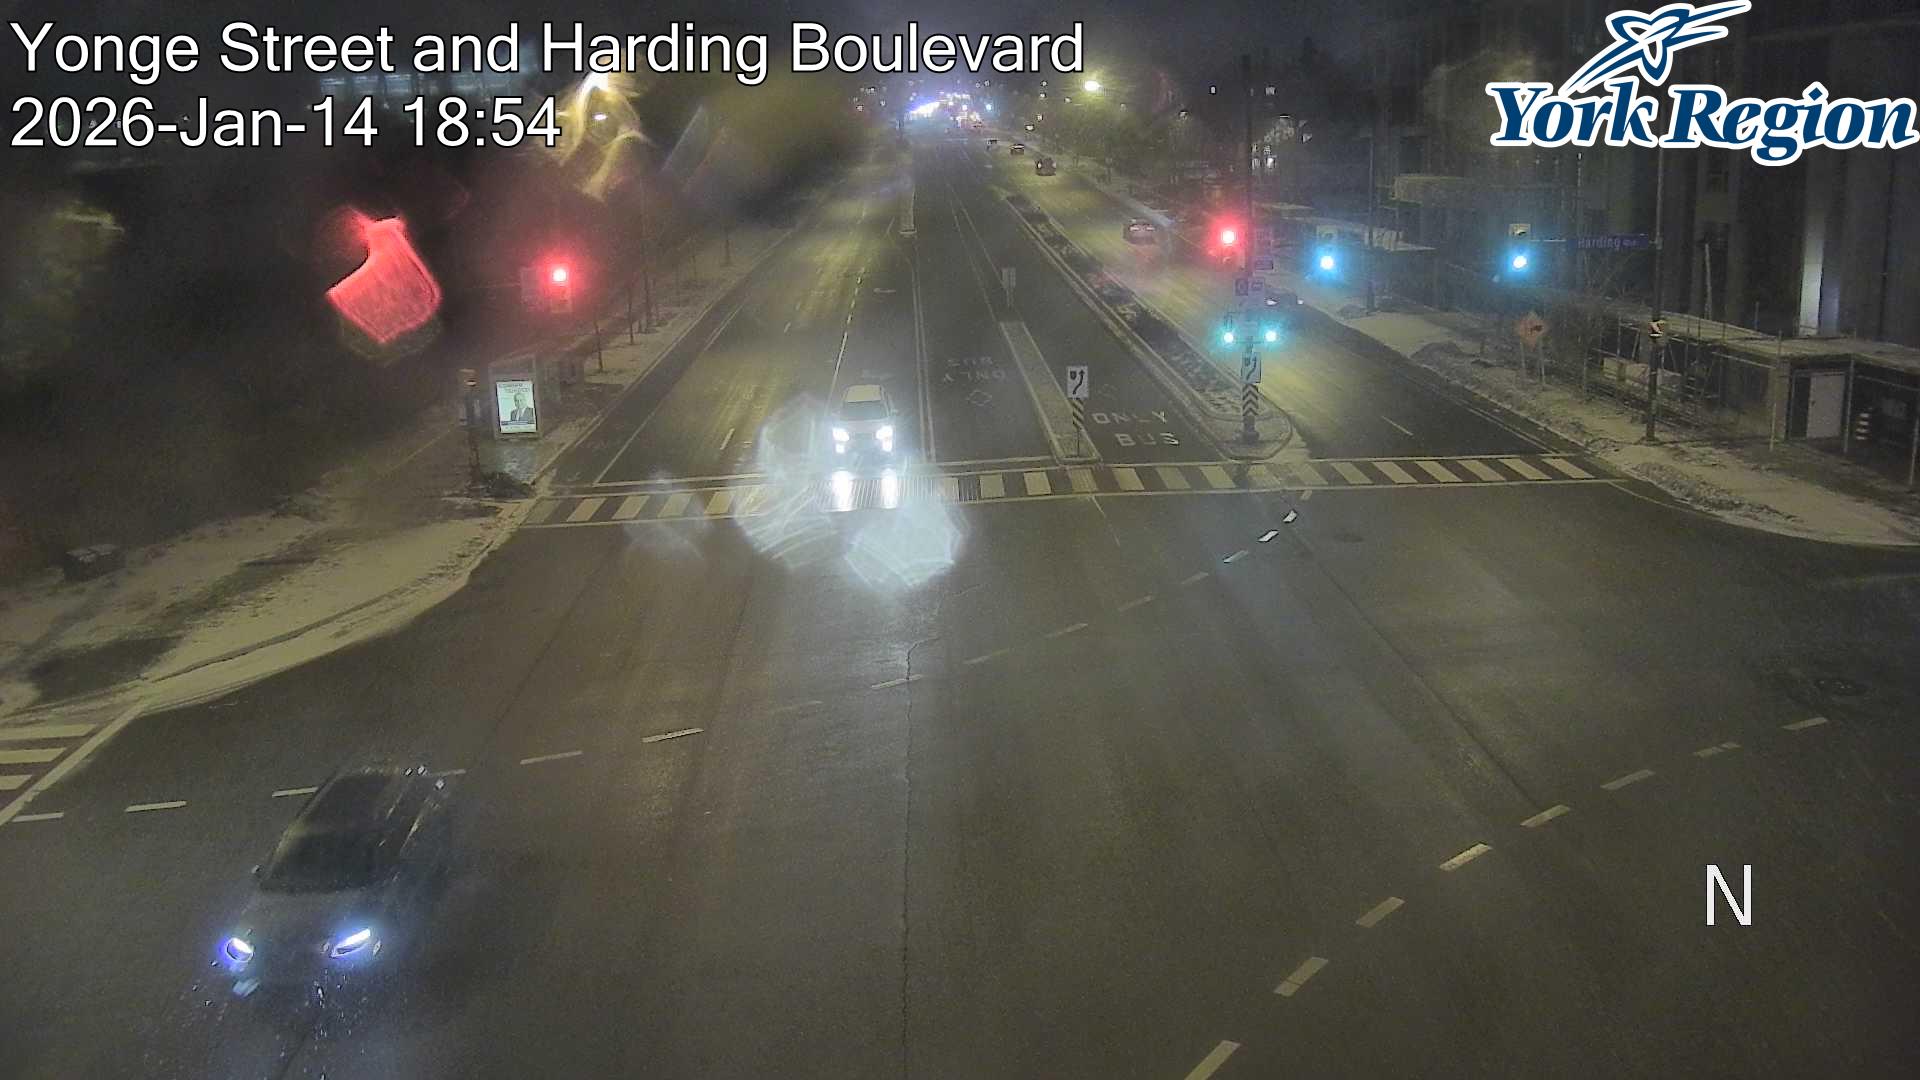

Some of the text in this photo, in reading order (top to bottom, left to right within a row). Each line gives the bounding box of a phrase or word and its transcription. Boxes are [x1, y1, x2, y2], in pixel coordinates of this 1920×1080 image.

[1578, 236, 1621, 250] Harding
[1091, 410, 1168, 424] ONLY
[1114, 431, 1180, 447] BUS
